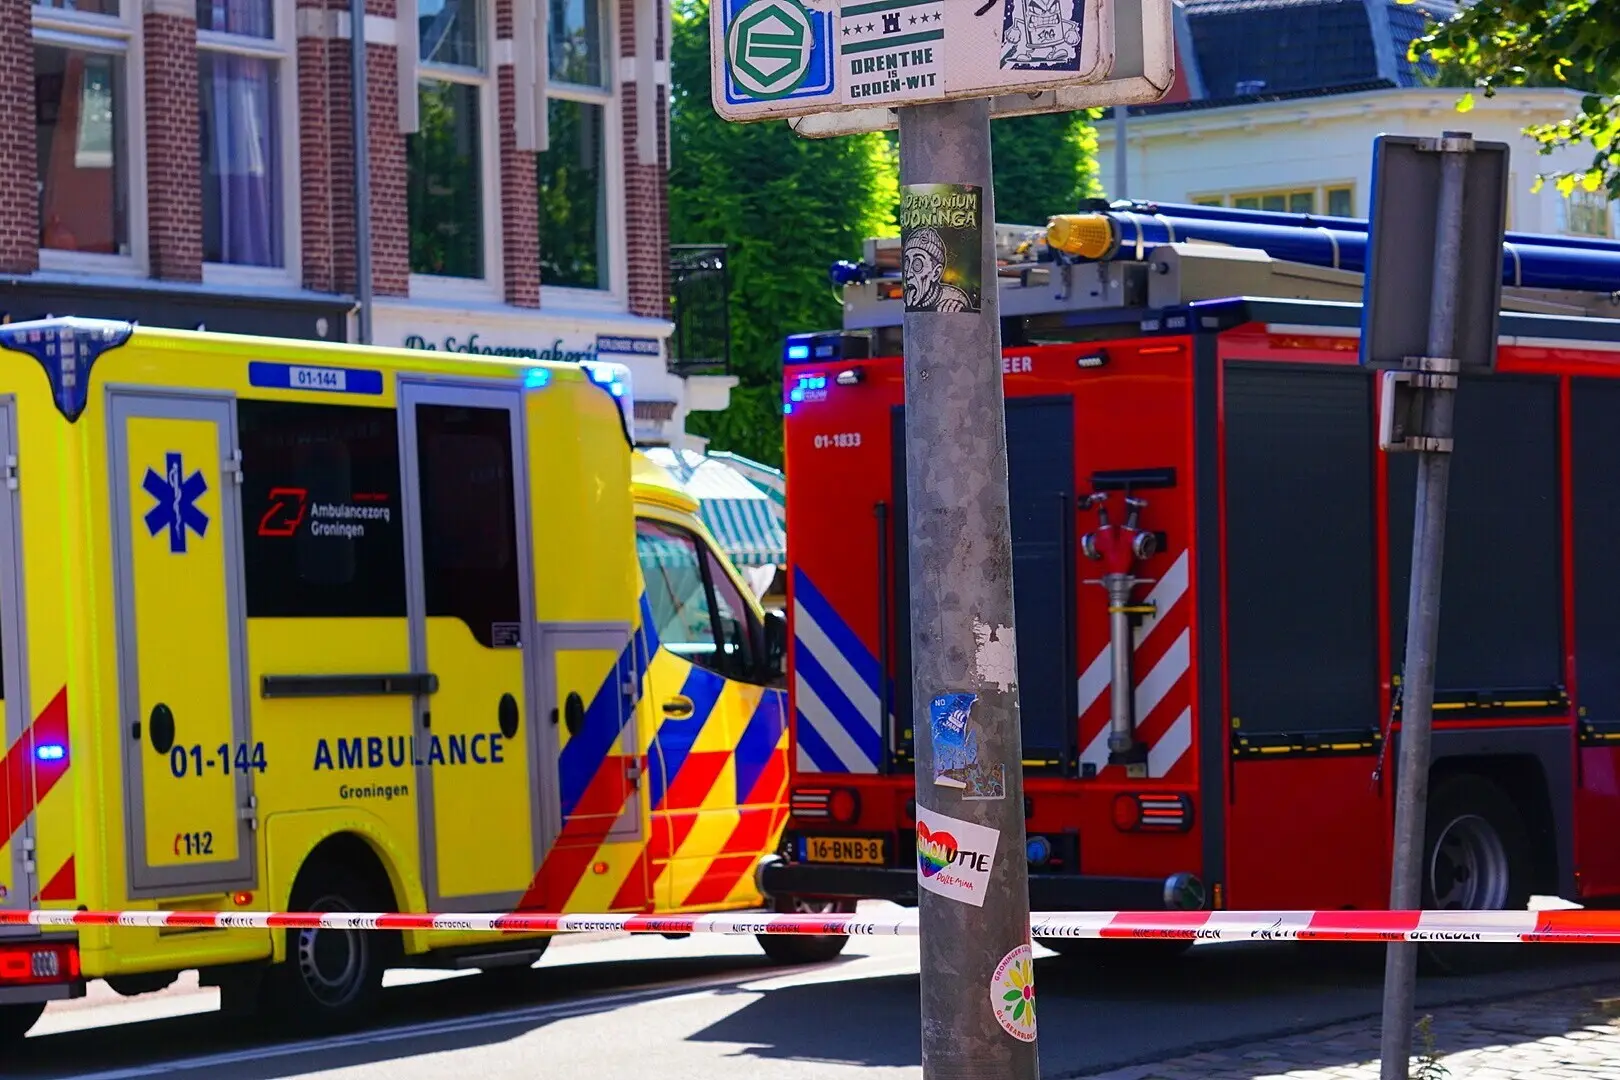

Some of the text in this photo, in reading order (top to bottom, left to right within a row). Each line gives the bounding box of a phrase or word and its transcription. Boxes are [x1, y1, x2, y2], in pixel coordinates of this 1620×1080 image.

[851, 48, 933, 75] DRENTHE
[887, 70, 898, 78] IS
[850, 73, 936, 98] GROEN-WIT
[297, 371, 338, 386] 01-144
[814, 432, 861, 448] 01-1833
[310, 503, 390, 522] Ambulancezorg
[310, 520, 364, 539] Groningen
[170, 734, 504, 777] 01-144 AMBULANCE
[339, 783, 409, 800] Groningen
[812, 841, 878, 860] 16-BNB-8
